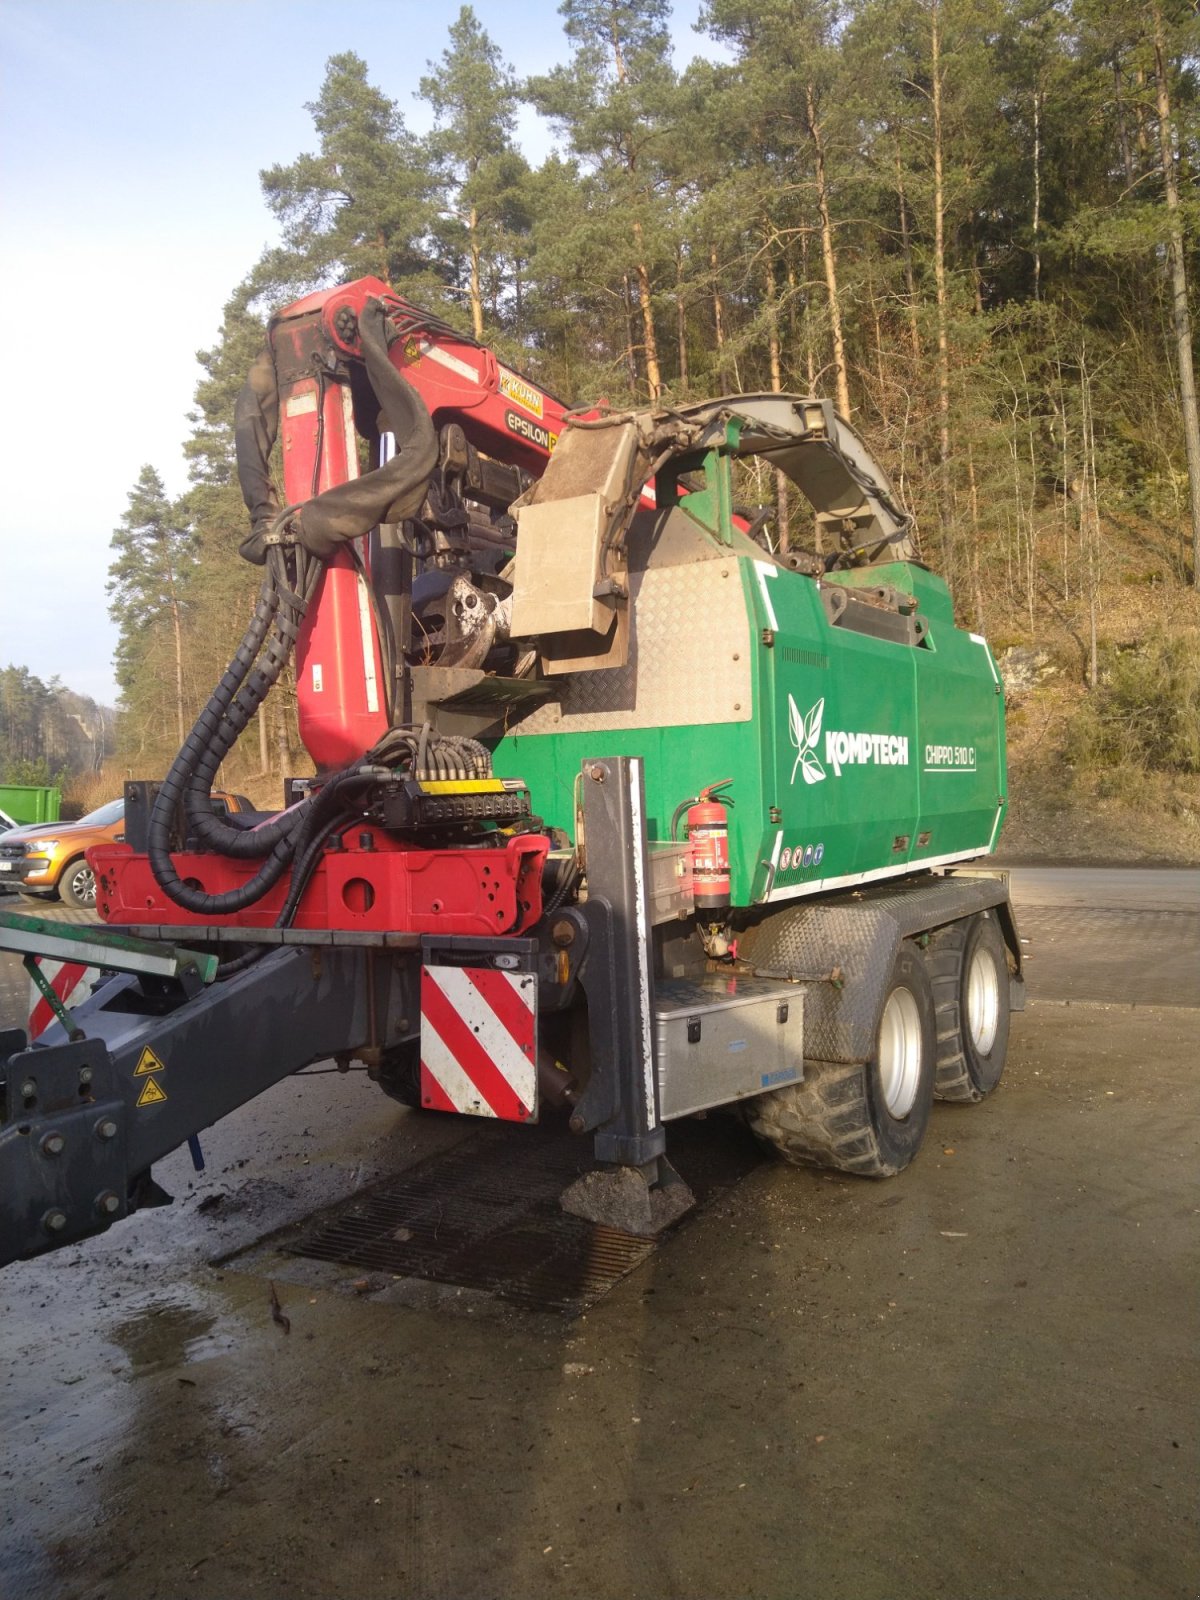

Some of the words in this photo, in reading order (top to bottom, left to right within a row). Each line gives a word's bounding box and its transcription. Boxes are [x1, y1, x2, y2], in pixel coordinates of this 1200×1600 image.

[512, 380, 540, 406] KUHN
[508, 413, 548, 447] EPSILON
[825, 731, 909, 777] KOMPTECH
[925, 745, 953, 765] CHIPPO
[955, 747, 967, 765] 510
[968, 748, 974, 765] C
